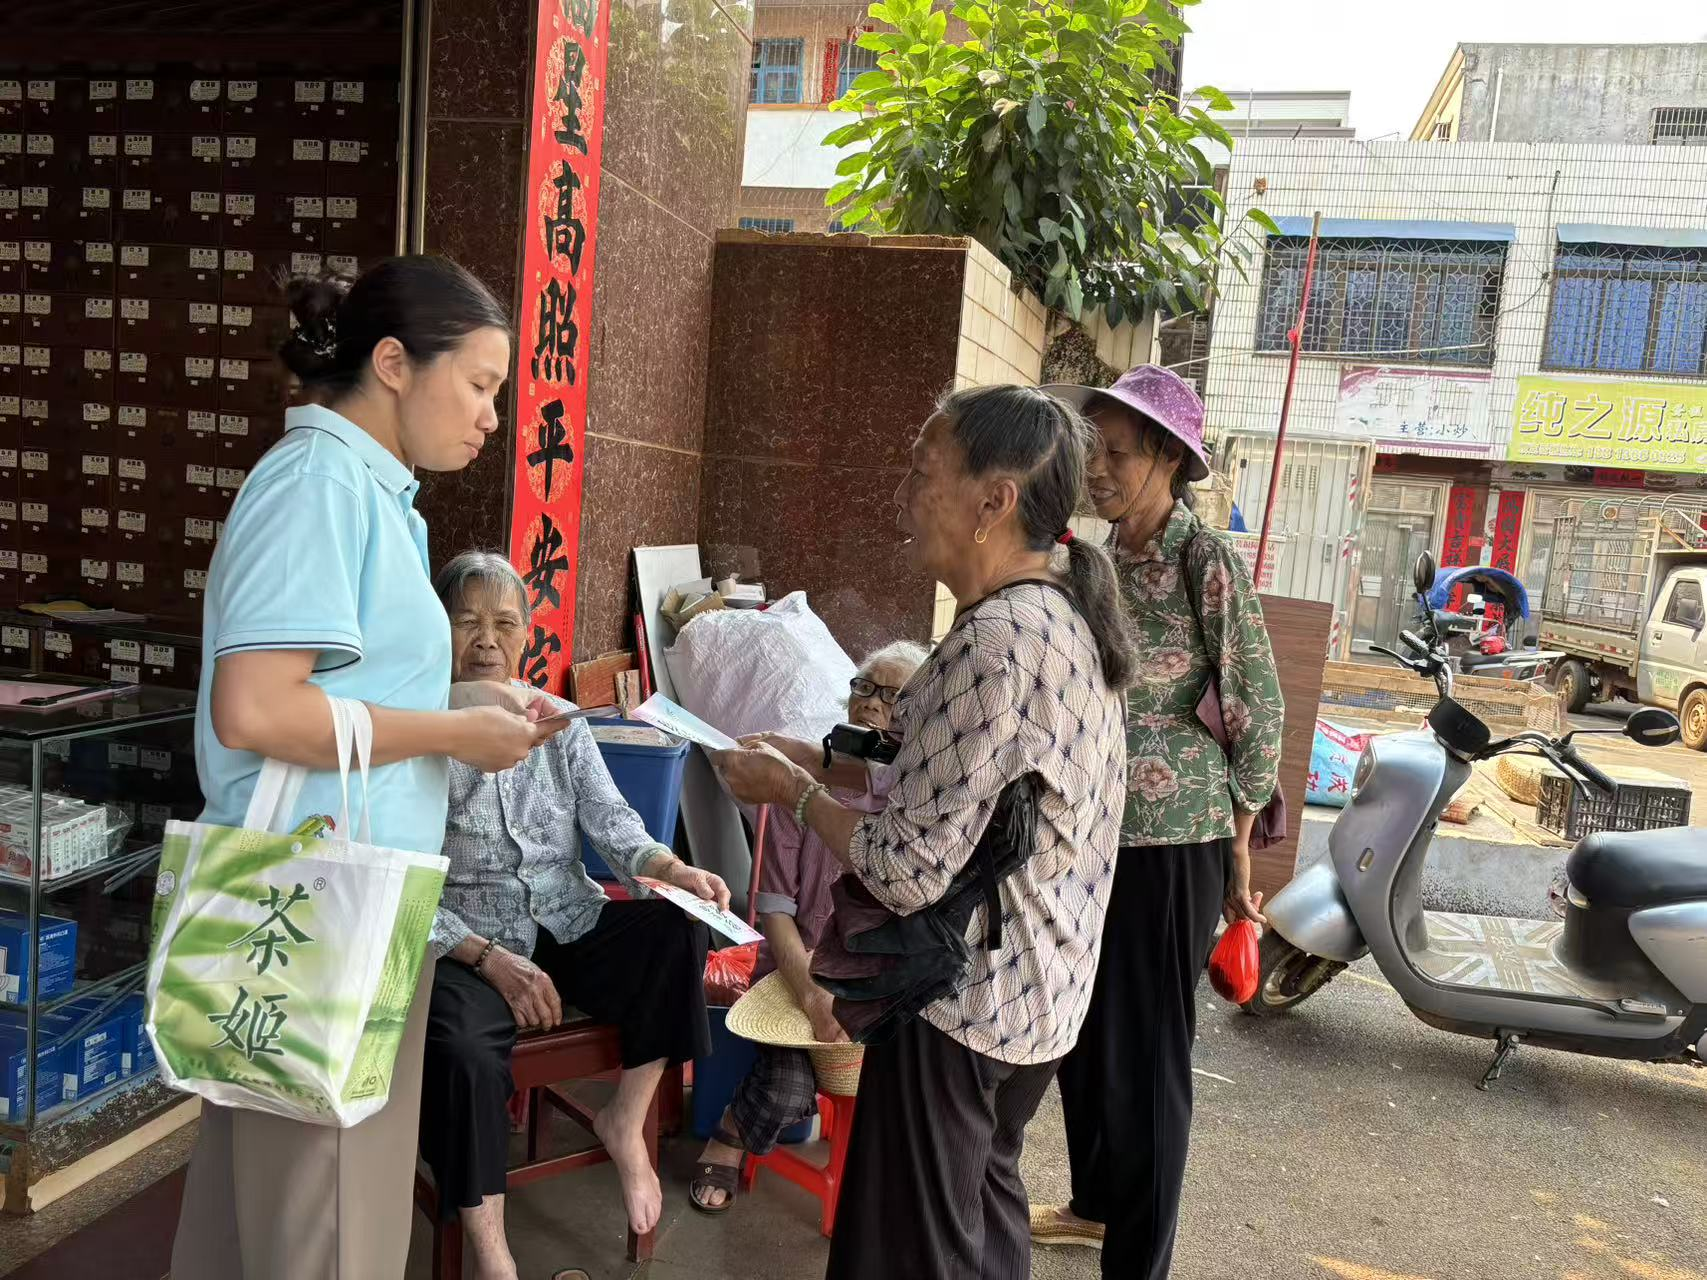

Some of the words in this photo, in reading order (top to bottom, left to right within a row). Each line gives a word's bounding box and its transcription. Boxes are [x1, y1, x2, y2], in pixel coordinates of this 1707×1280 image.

[1519, 390, 1667, 442] 纯之源
[207, 882, 315, 1061] 茶姬
